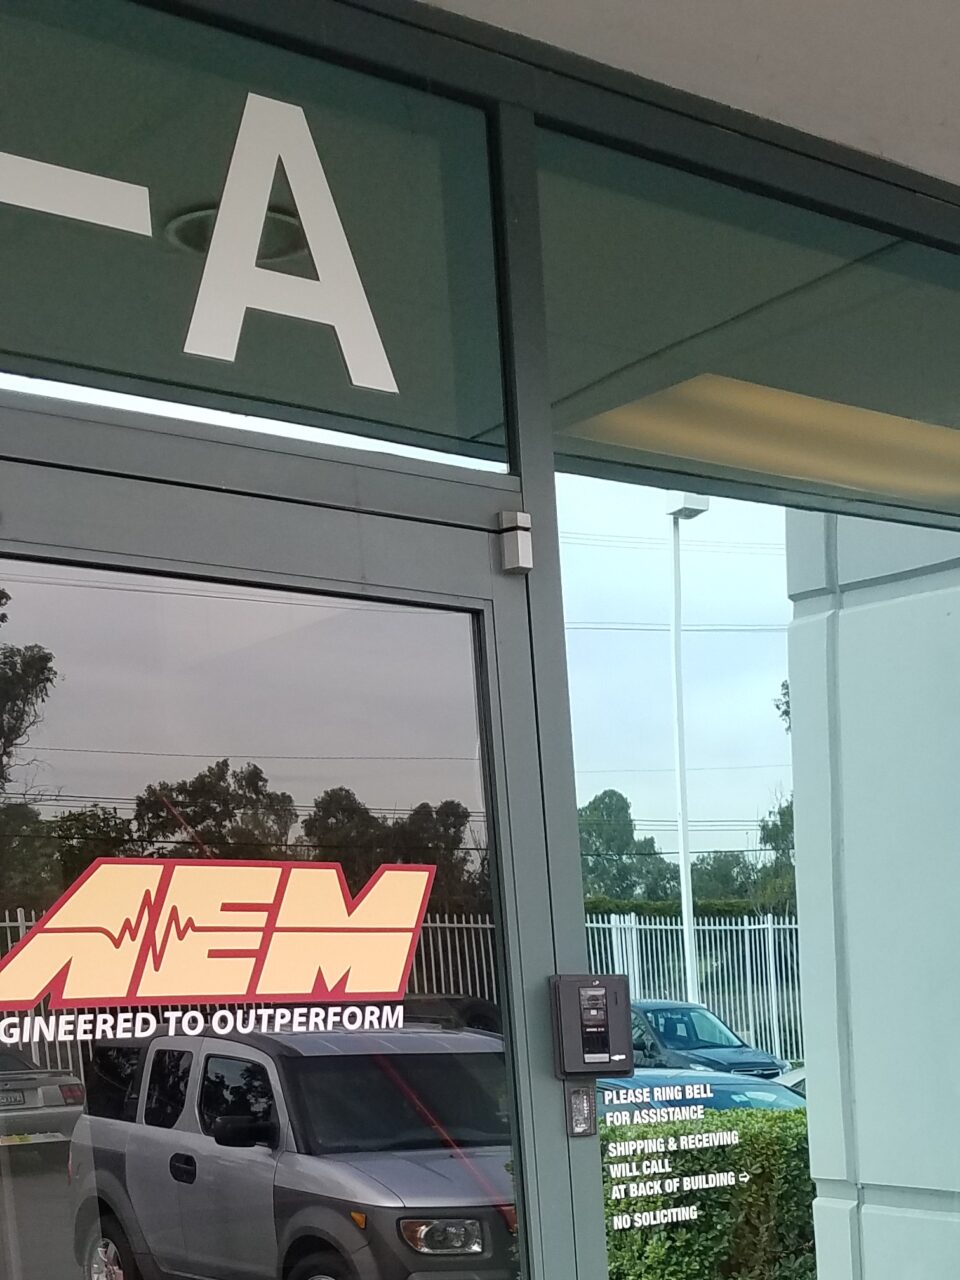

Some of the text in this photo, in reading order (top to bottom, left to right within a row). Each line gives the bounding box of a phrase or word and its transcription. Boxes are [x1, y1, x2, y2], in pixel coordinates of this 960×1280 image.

[0, 858, 437, 1009] AEM
[0, 1005, 404, 1044] GINEERED TO OUTPERFORM
[604, 1084, 714, 1105] PLEASE RING BELL
[605, 1105, 705, 1126] FOR ASSISTANCE
[608, 1131, 739, 1157] SHIPPING & RECEIVING
[609, 1158, 672, 1179] WILL CALL
[611, 1171, 736, 1200] AT BACK OF BUILDING
[613, 1205, 698, 1230] NO SOLICITING
